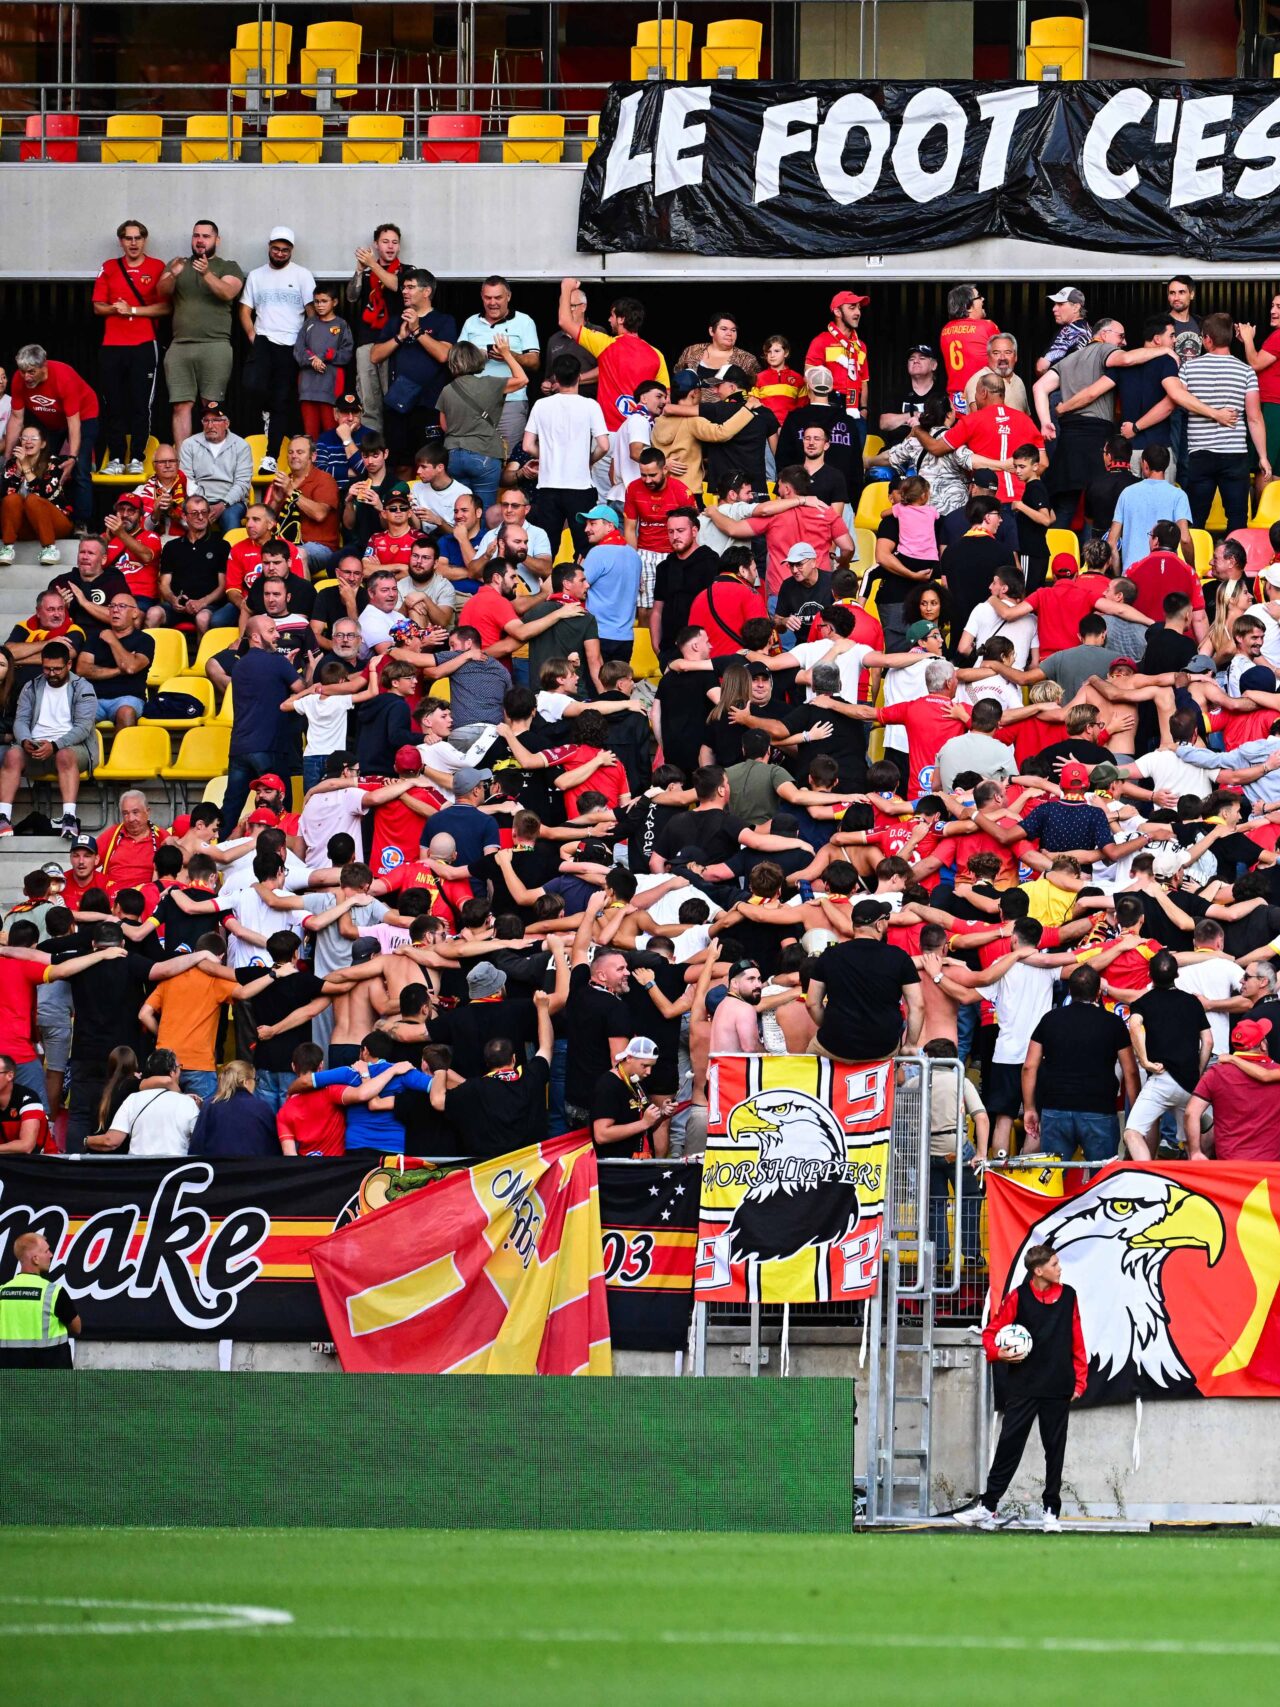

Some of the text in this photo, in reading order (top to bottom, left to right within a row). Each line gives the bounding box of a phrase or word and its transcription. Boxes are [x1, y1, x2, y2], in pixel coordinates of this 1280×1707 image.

[601, 86, 711, 199] LE
[755, 85, 1038, 205] FOOT
[949, 340, 963, 370] 6
[845, 1062, 891, 1125] 9
[703, 1156, 882, 1194] WORSHIPPERS
[0, 1162, 270, 1330] nake
[840, 1228, 880, 1291] 2
